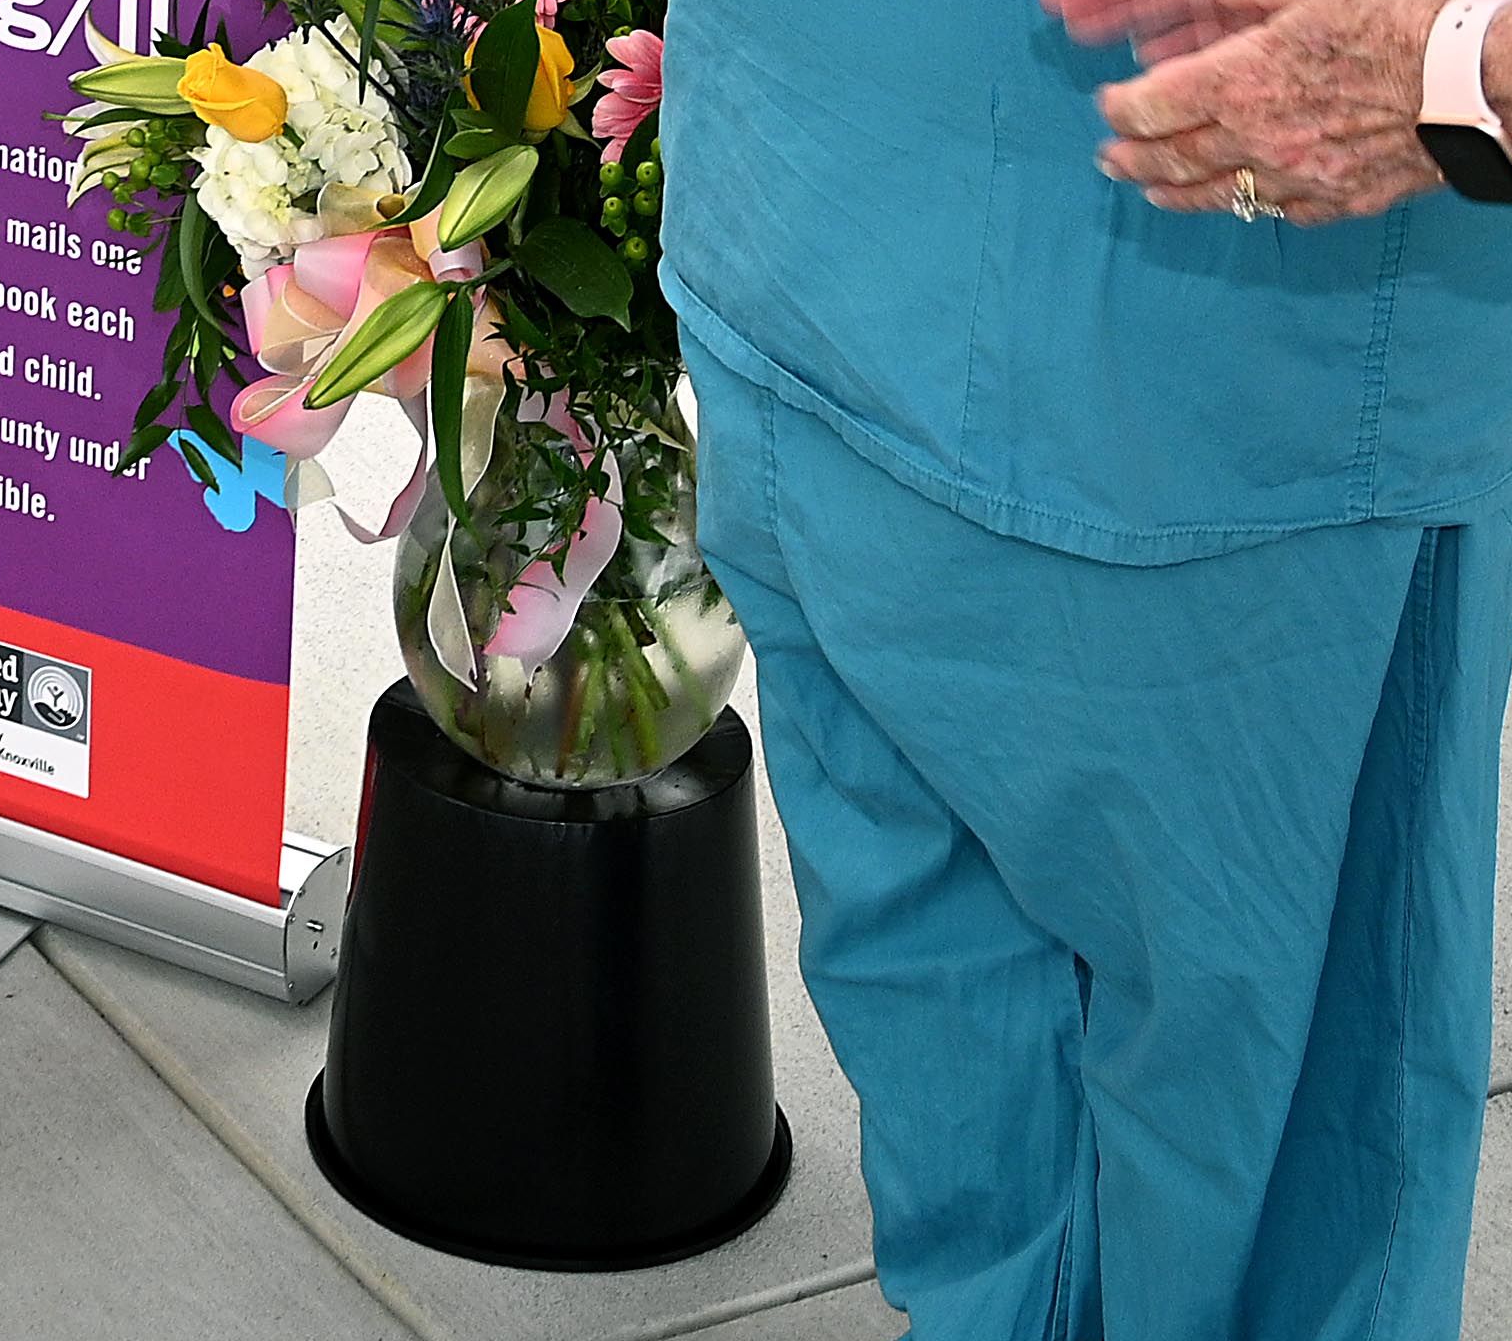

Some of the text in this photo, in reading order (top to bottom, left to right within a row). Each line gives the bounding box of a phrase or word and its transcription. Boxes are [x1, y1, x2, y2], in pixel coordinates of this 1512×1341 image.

[6, 216, 81, 259] mails
[91, 240, 142, 275] one
[68, 301, 135, 342] each
[24, 357, 102, 401] child.
